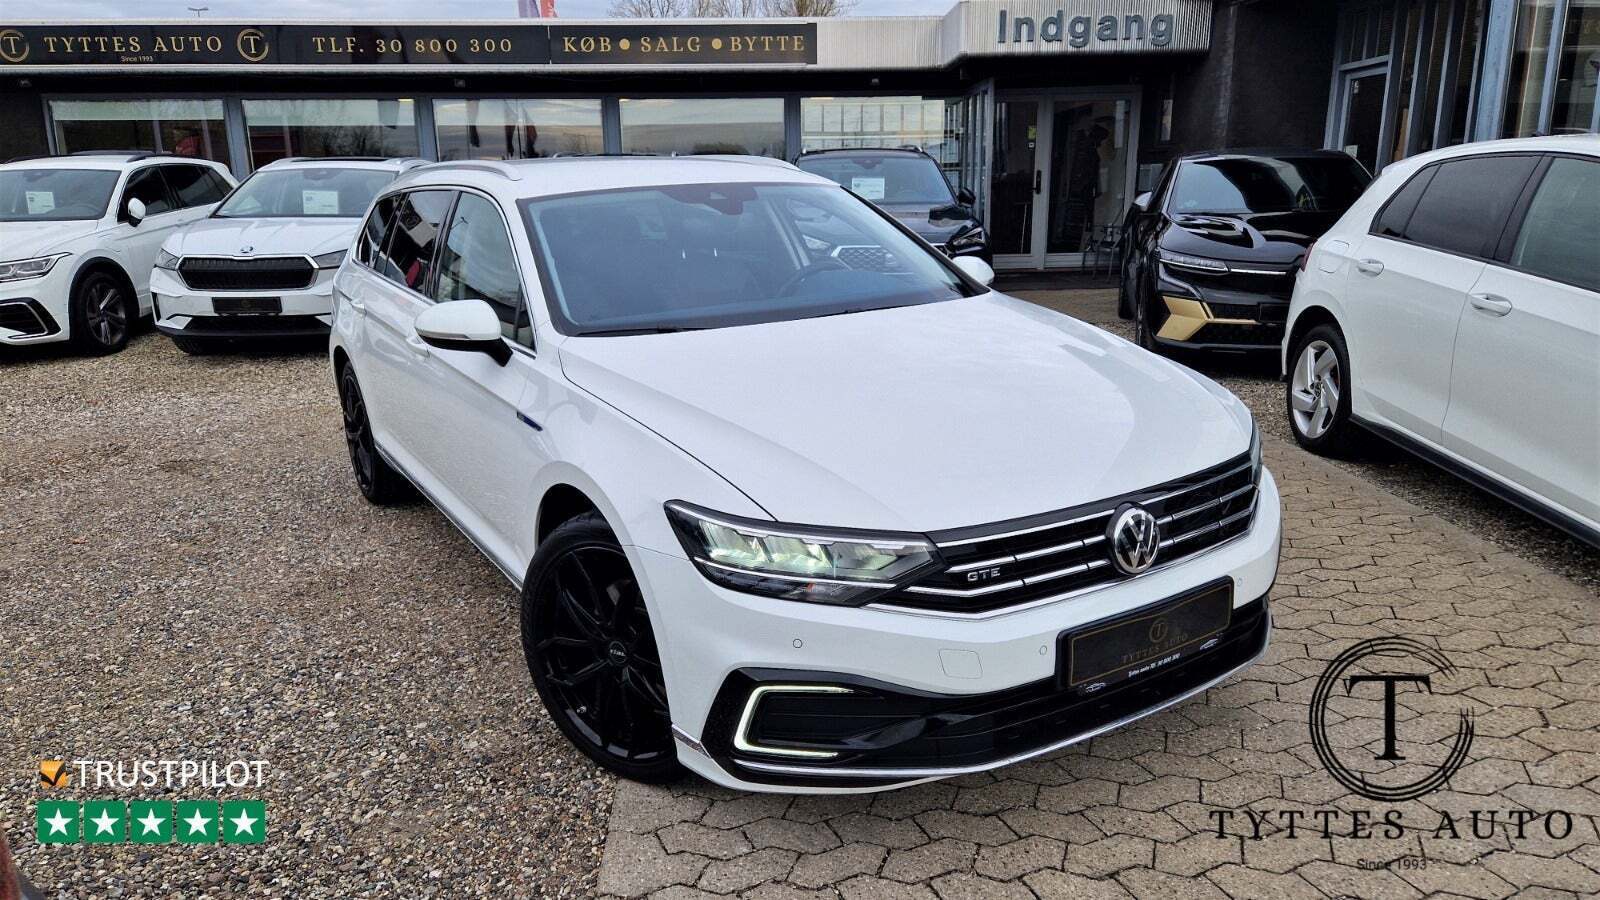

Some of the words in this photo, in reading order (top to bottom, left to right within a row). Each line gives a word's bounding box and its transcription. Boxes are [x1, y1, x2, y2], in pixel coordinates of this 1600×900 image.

[998, 10, 1173, 48] Indgang
[44, 36, 142, 53] TYTTES
[154, 36, 222, 53] AUTO
[312, 37, 364, 53] TLF.
[376, 39, 401, 53] 30
[415, 39, 457, 53] 800
[470, 39, 512, 53] 300
[563, 36, 612, 53] KØB
[640, 36, 700, 53] SALG
[729, 35, 805, 52] BYTTE
[967, 567, 1000, 581] GTE
